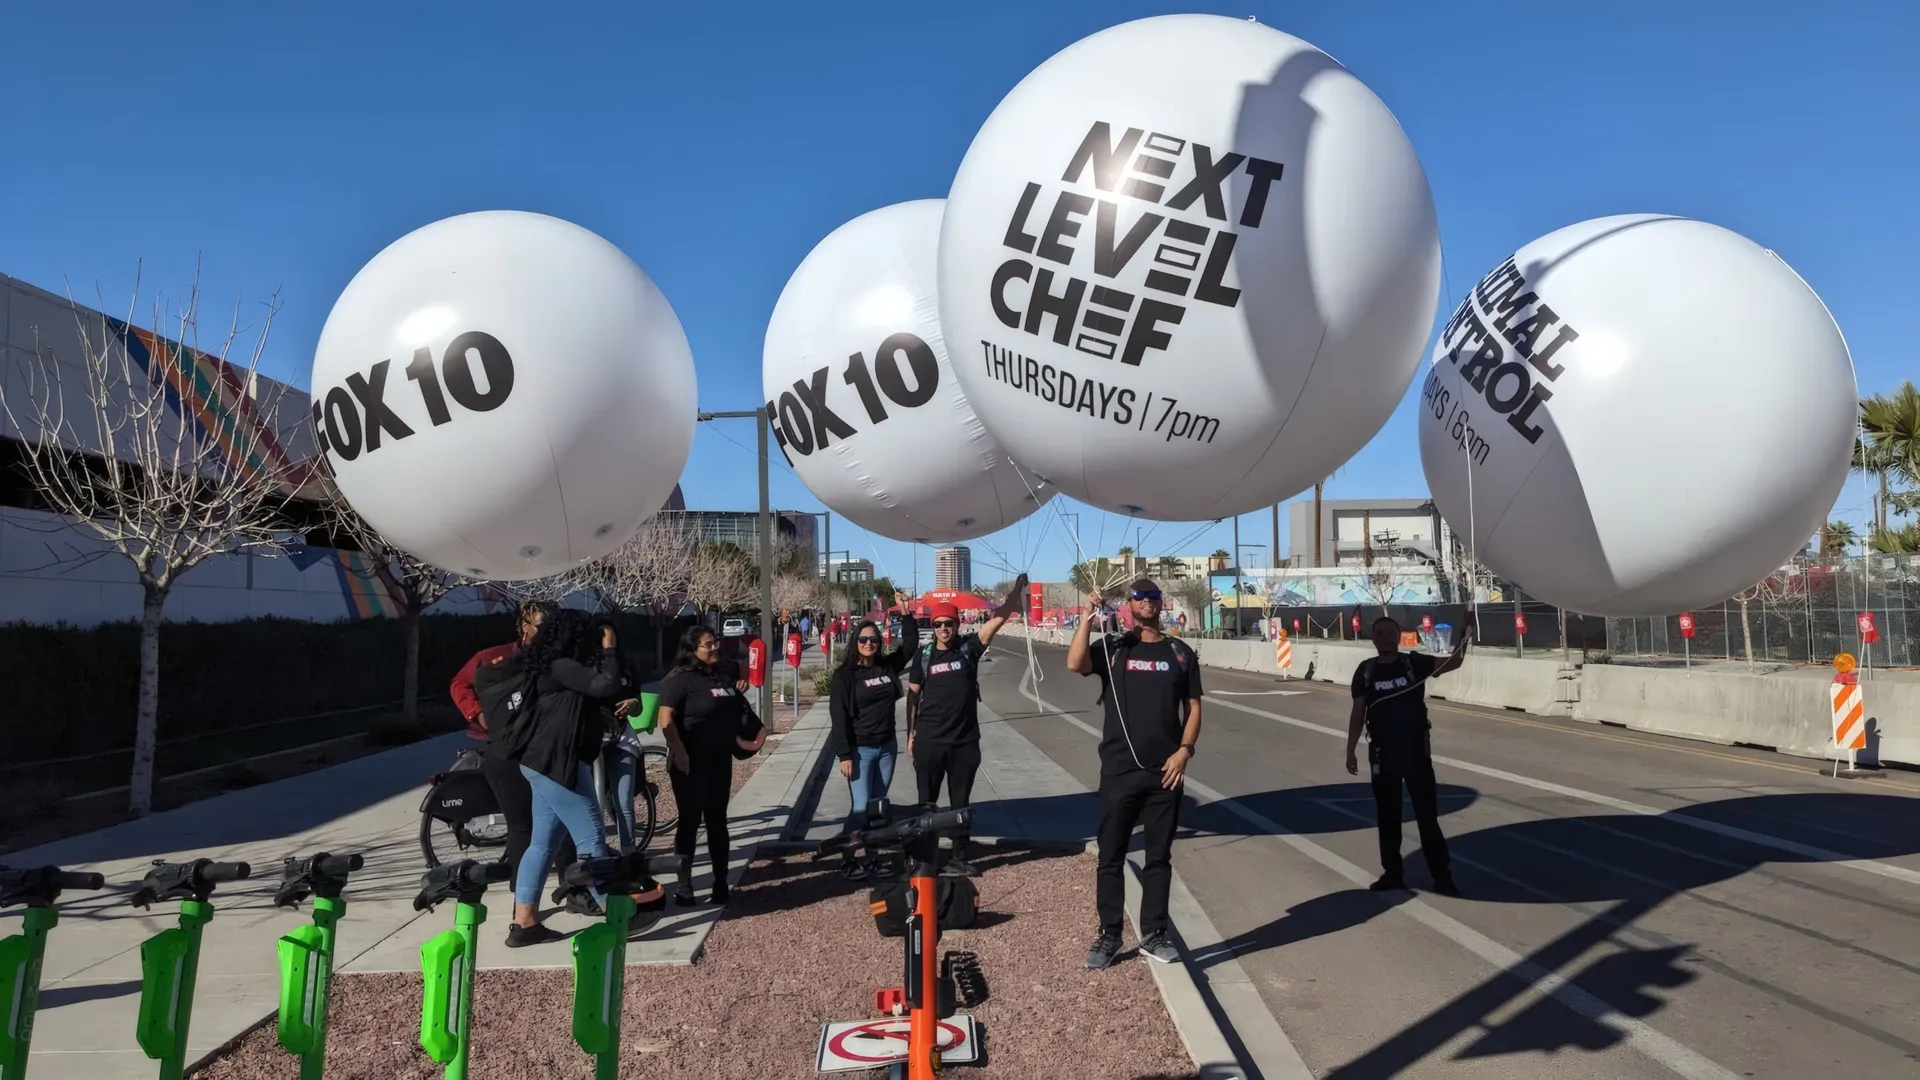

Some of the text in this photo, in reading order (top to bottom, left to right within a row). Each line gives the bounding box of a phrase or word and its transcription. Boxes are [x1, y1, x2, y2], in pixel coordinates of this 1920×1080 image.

[1061, 121, 1285, 229] NEXT
[1003, 181, 1242, 308] LEVEL
[990, 258, 1187, 367] CHEF
[1475, 252, 1580, 383] NIMAL
[312, 331, 515, 478] FOX 10
[766, 332, 939, 468] FOX 10
[981, 339, 1221, 443] THURSDAYS 7pm
[1442, 290, 1554, 445] NTROL
[930, 661, 961, 675] FOX 10
[1128, 659, 1169, 671] FOX 10
[1374, 677, 1407, 690] FOX 10
